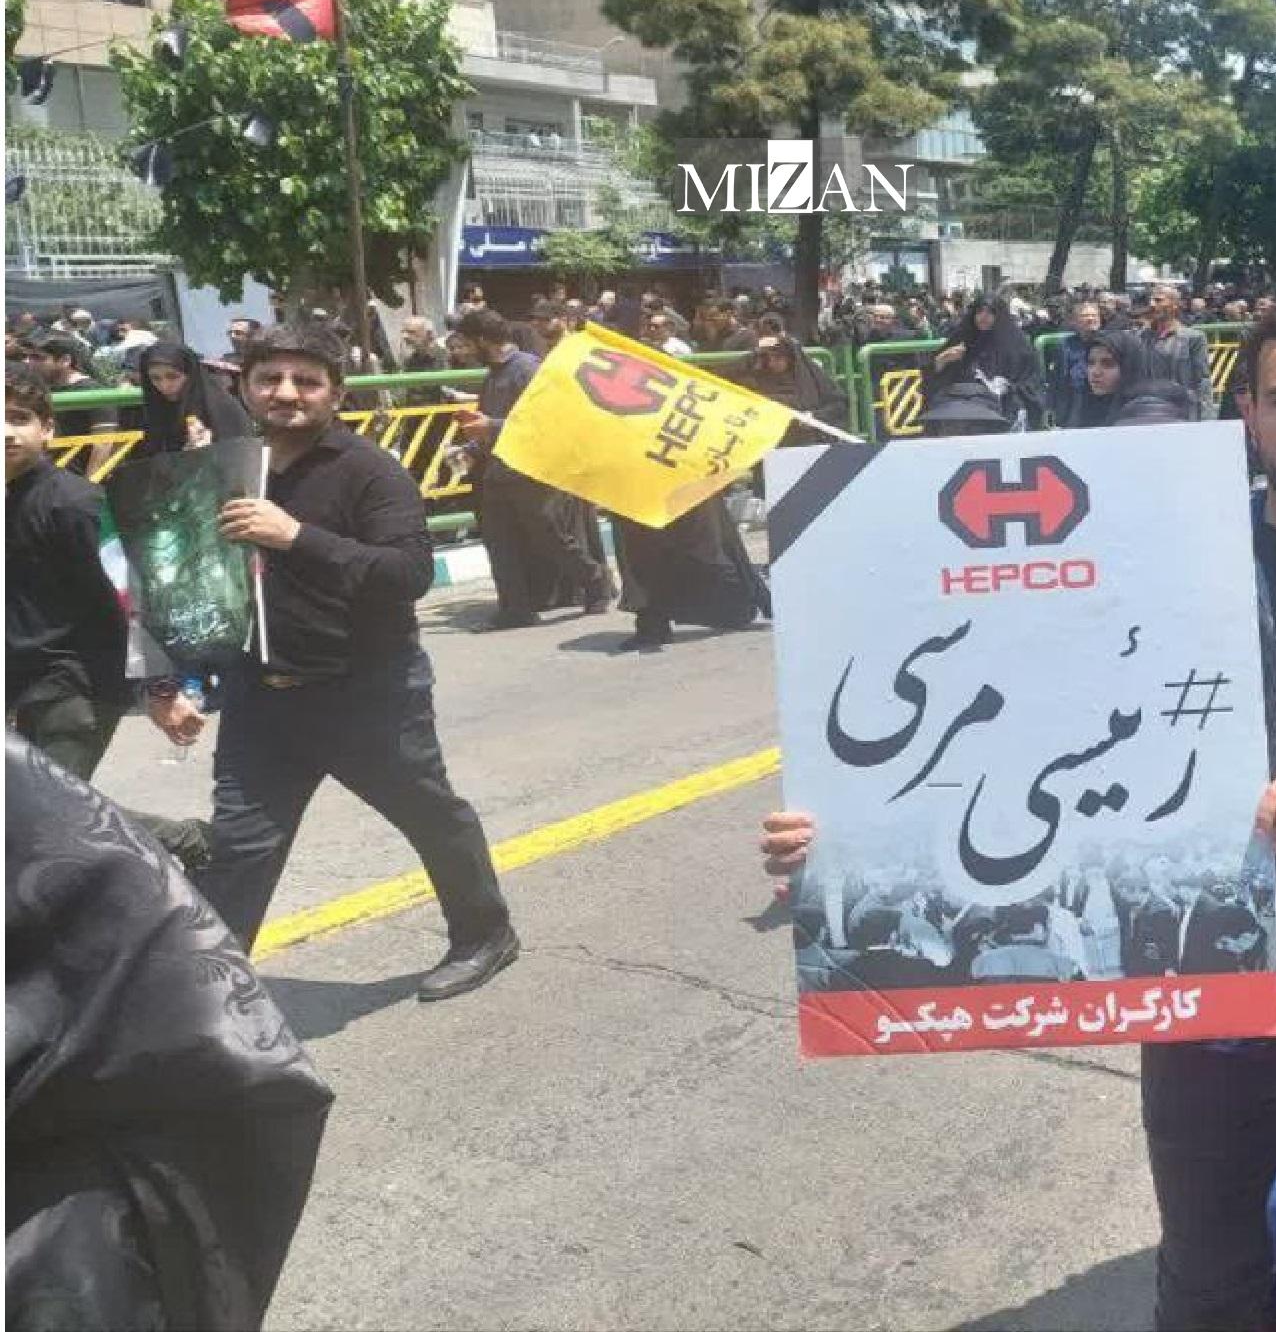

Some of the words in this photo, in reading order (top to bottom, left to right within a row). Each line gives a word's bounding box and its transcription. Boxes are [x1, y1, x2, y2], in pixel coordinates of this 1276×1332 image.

[942, 561, 1096, 596] HEPCO
[874, 1002, 973, 1044] هپکو
[982, 996, 1069, 1037] شرکت
[1078, 987, 1202, 1033] کارگران
